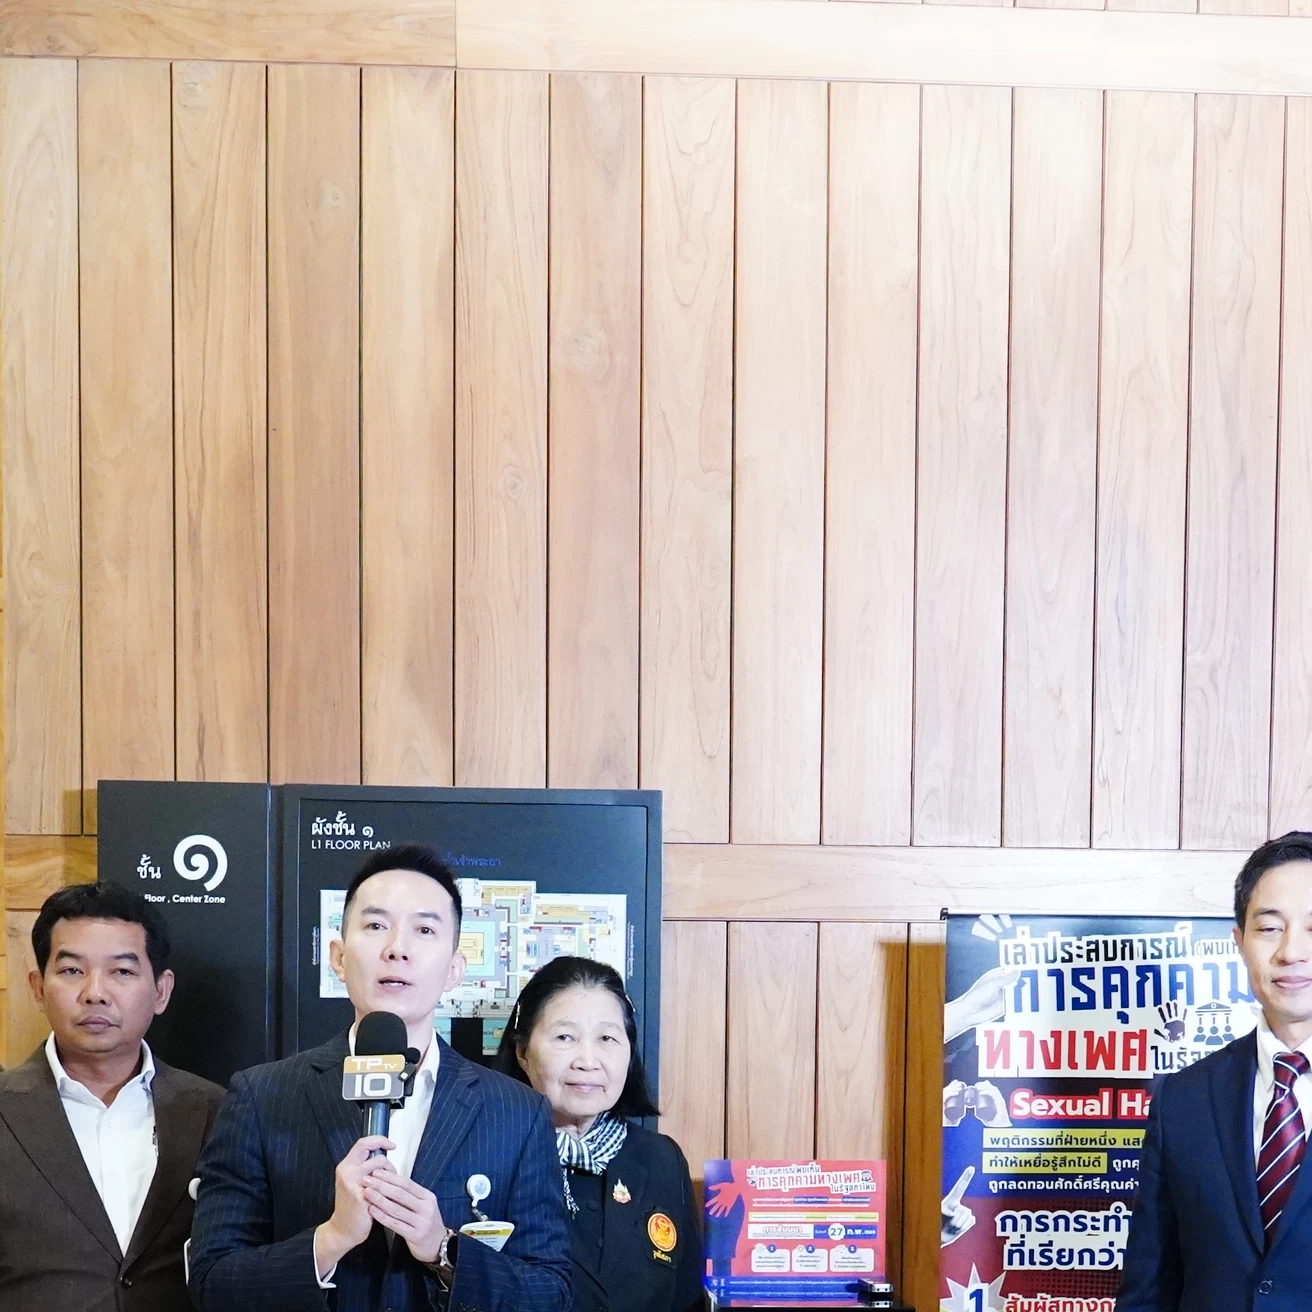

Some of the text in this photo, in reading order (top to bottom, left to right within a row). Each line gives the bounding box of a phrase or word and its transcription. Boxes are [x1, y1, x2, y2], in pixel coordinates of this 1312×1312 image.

[311, 810, 355, 836] ผังชั้น
[311, 840, 391, 850] L1 FLOOR PLAN
[136, 854, 162, 880] ชั้น
[172, 894, 203, 904] Center
[204, 895, 226, 904] Zone
[1003, 926, 1187, 966] เล่าประสบการณ์
[984, 1029, 1148, 1072] ทางเพศ
[1012, 1091, 1109, 1116] Sexual
[758, 1172, 860, 1191] การคุกคามทางเพศ
[830, 1228, 843, 1236] 27
